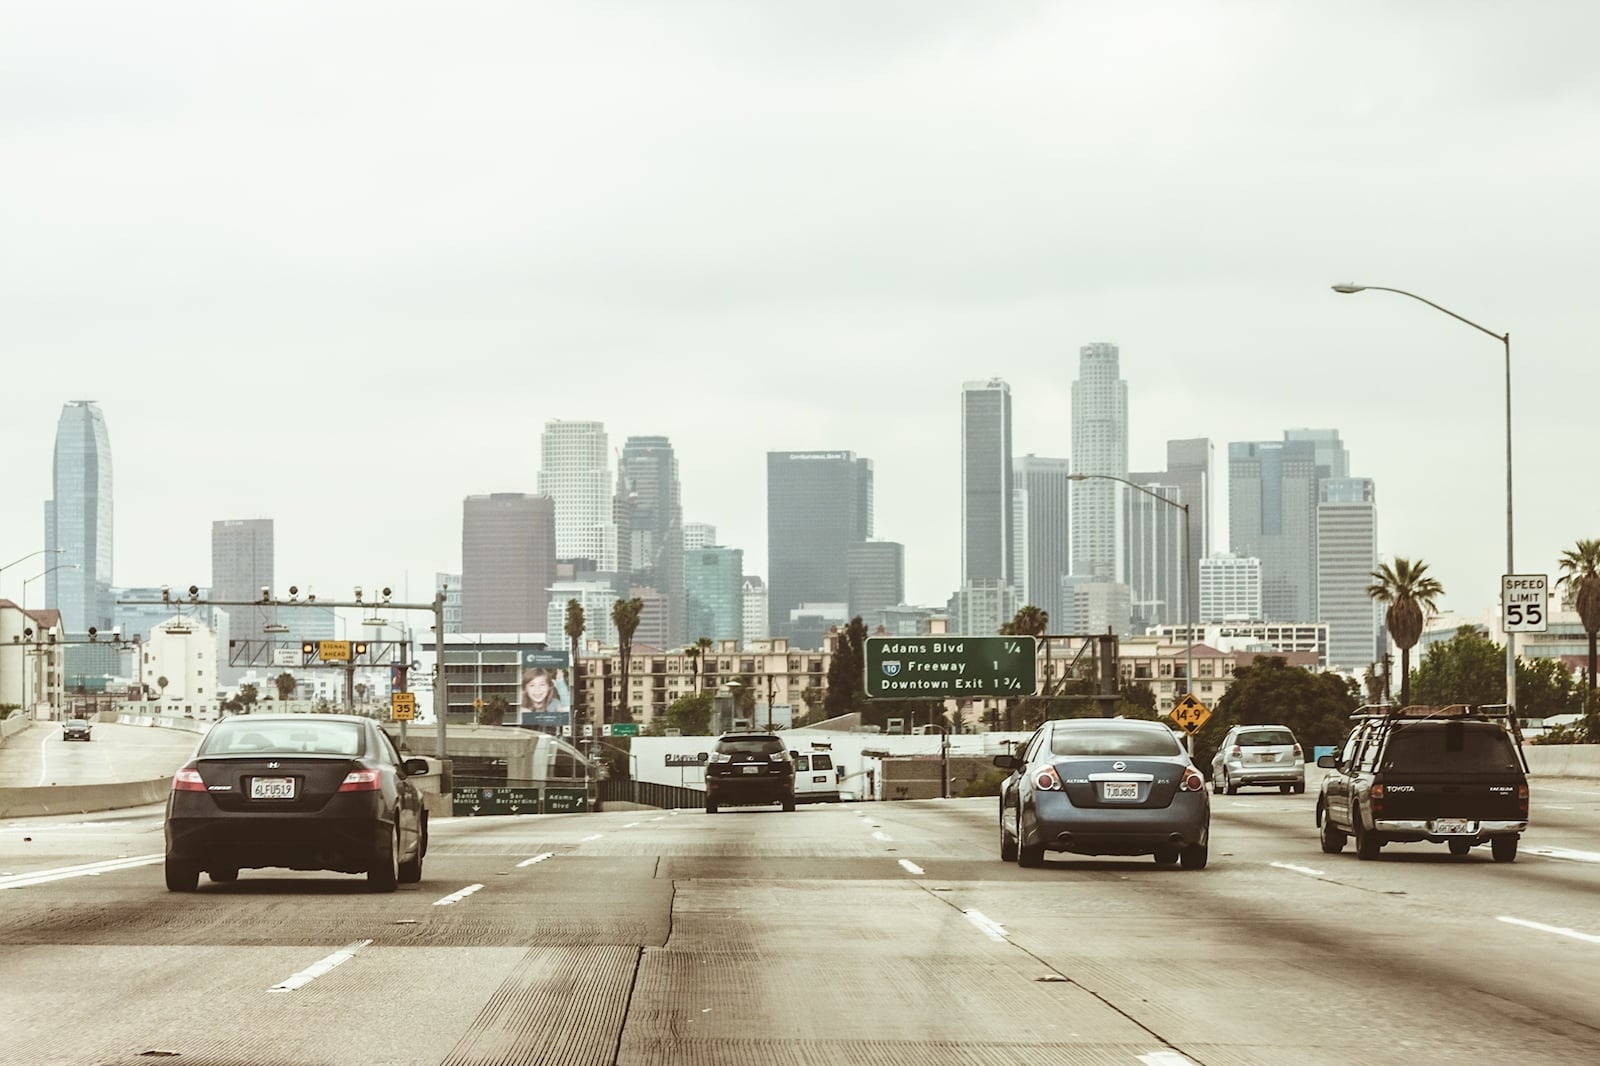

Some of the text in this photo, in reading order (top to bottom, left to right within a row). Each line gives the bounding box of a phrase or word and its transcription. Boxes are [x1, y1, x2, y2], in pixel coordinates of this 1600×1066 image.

[1506, 580, 1544, 589] SPEED
[1510, 593, 1540, 602] LIMIT
[1507, 604, 1542, 625] 55
[881, 643, 927, 653] Adams
[933, 643, 965, 653] Blvd
[887, 661, 998, 674] 10 Freeway 1
[881, 680, 949, 689] Downtown
[955, 678, 983, 689] Exit
[396, 704, 411, 713] 35
[255, 784, 292, 796] 6LFU519
